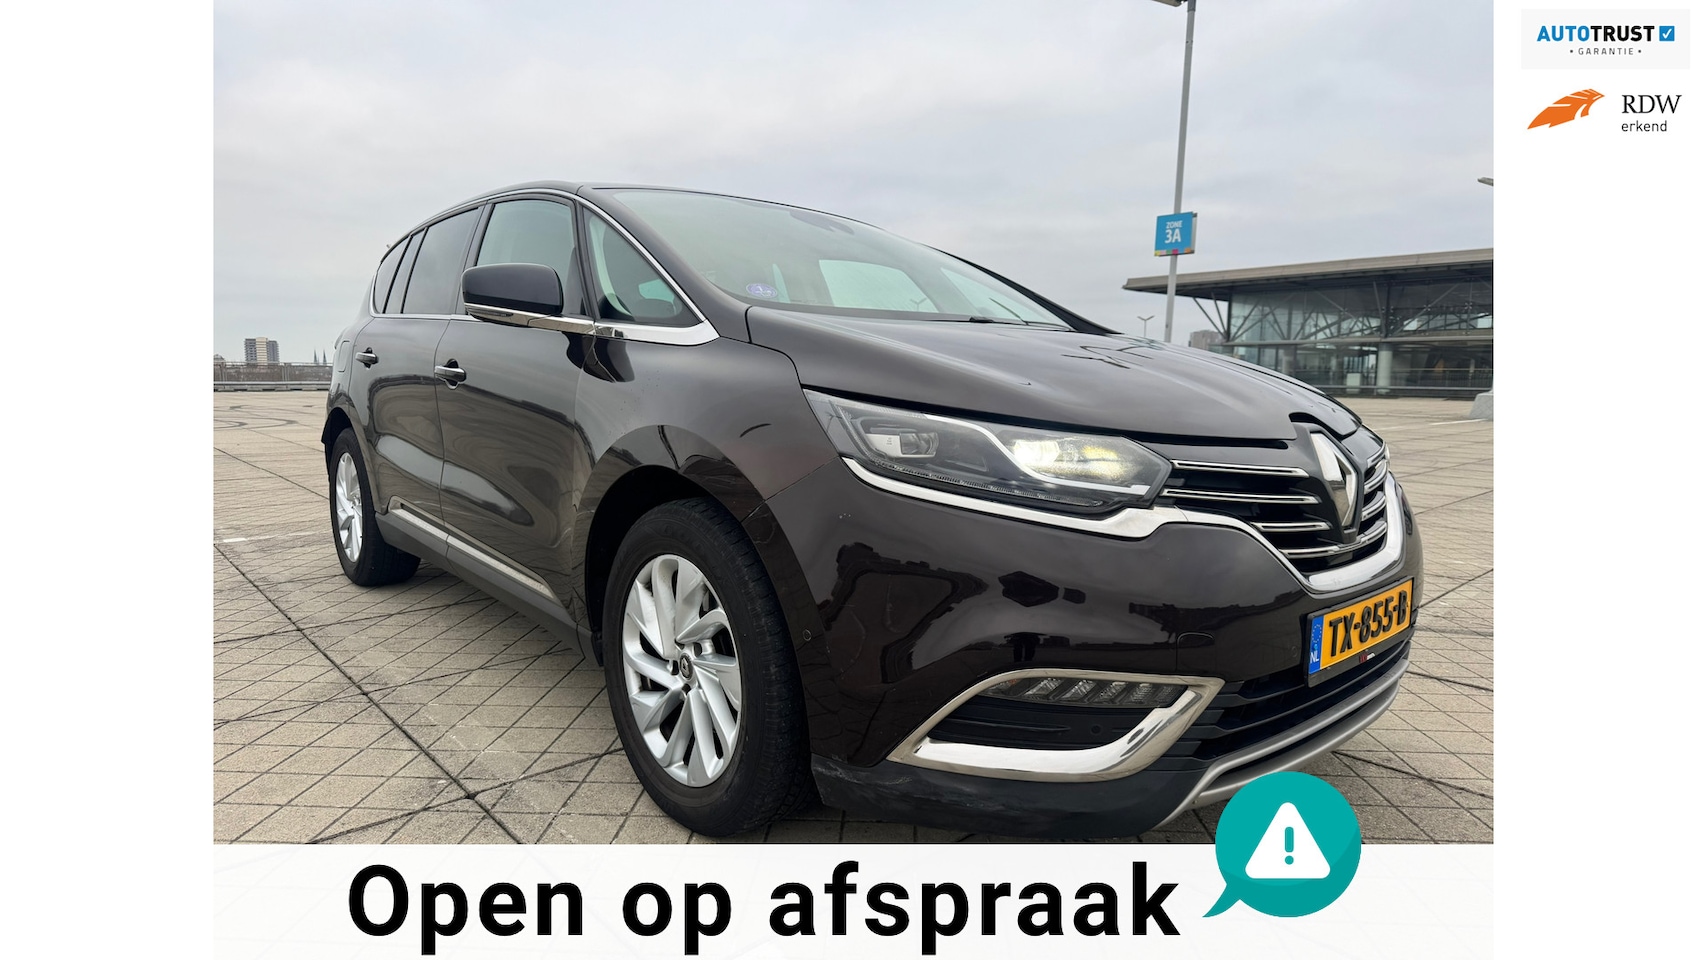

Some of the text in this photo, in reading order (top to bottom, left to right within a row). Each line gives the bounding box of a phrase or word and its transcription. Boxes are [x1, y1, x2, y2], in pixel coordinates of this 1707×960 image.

[1165, 220, 1183, 229] ZONE
[1164, 228, 1182, 244] 3A
[1329, 589, 1408, 657] TX-855-B
[1309, 650, 1320, 664] NL
